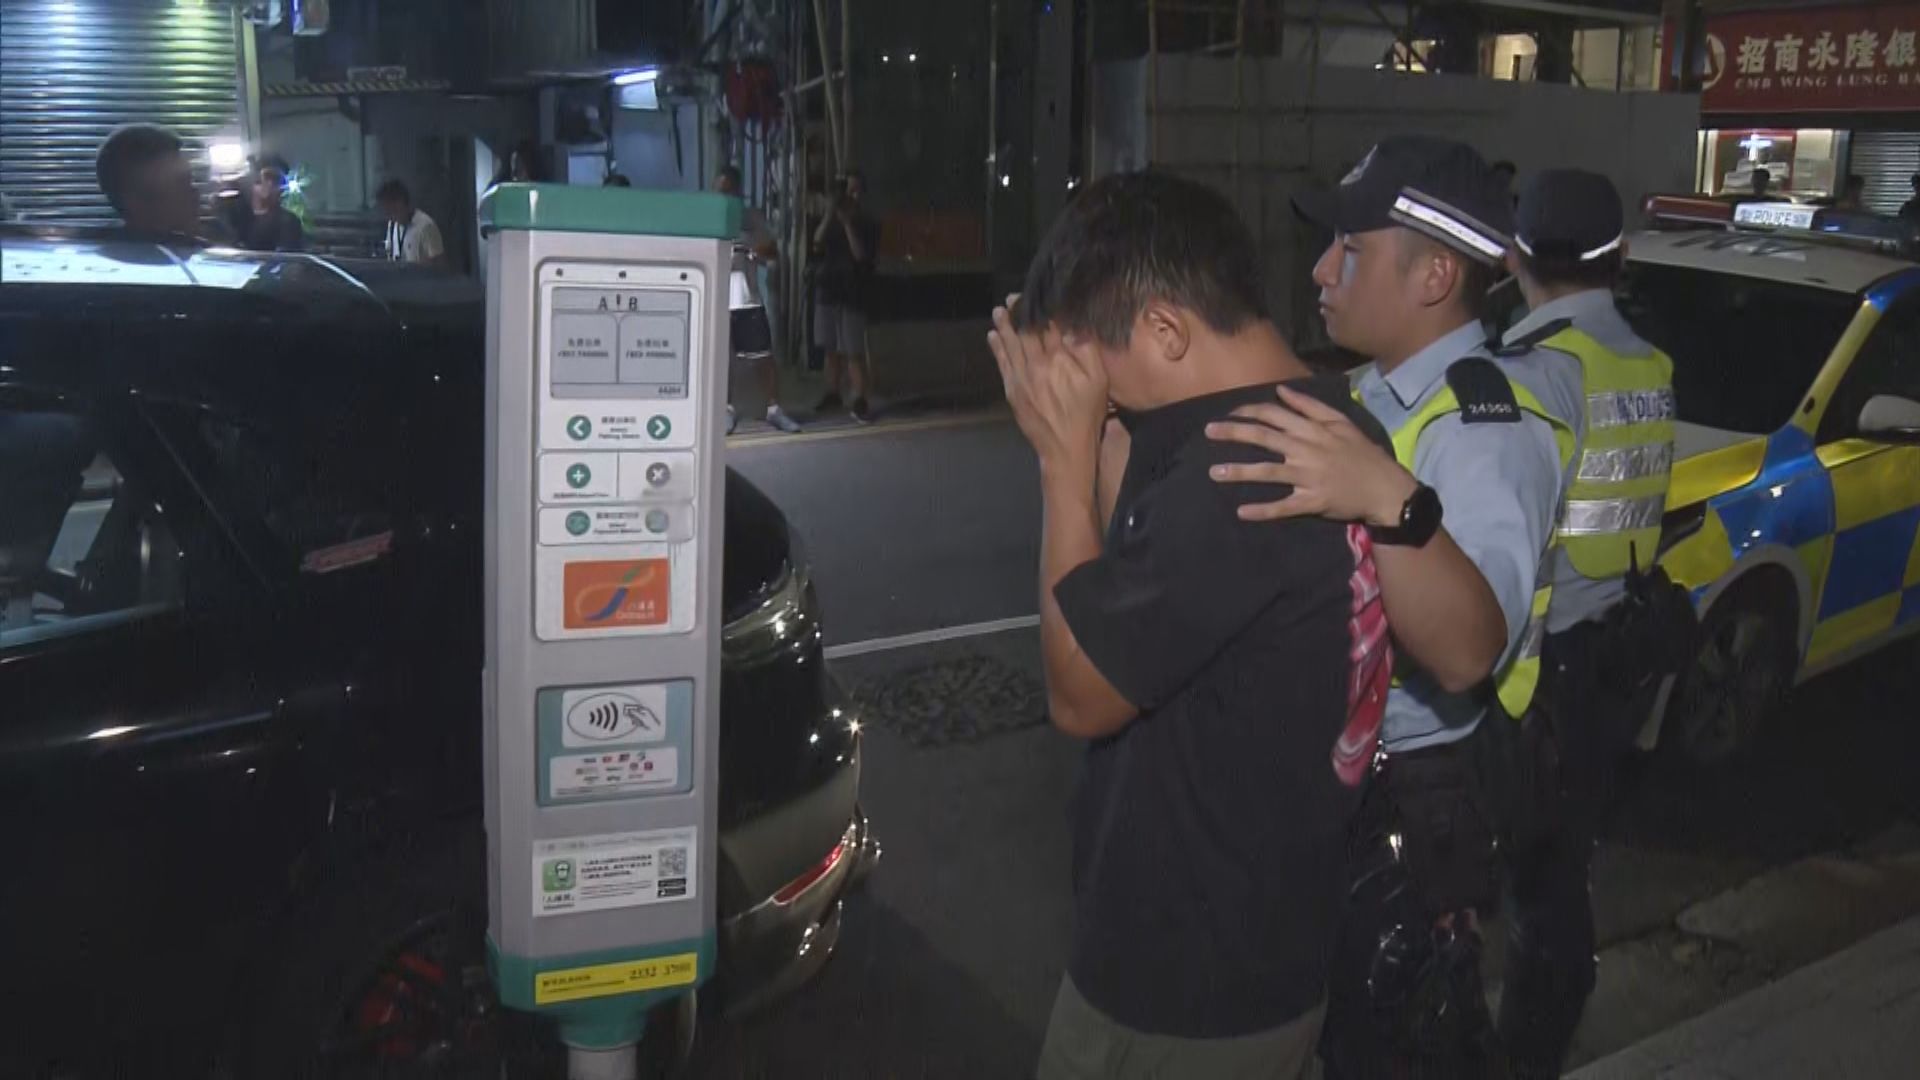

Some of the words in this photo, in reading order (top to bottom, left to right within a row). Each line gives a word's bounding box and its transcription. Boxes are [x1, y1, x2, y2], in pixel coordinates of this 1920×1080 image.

[1736, 27, 1917, 73] 招商永隆銀
[1780, 75, 1828, 88] WING
[1754, 208, 1793, 226] POLICE
[598, 297, 608, 310] A
[629, 296, 638, 311] B
